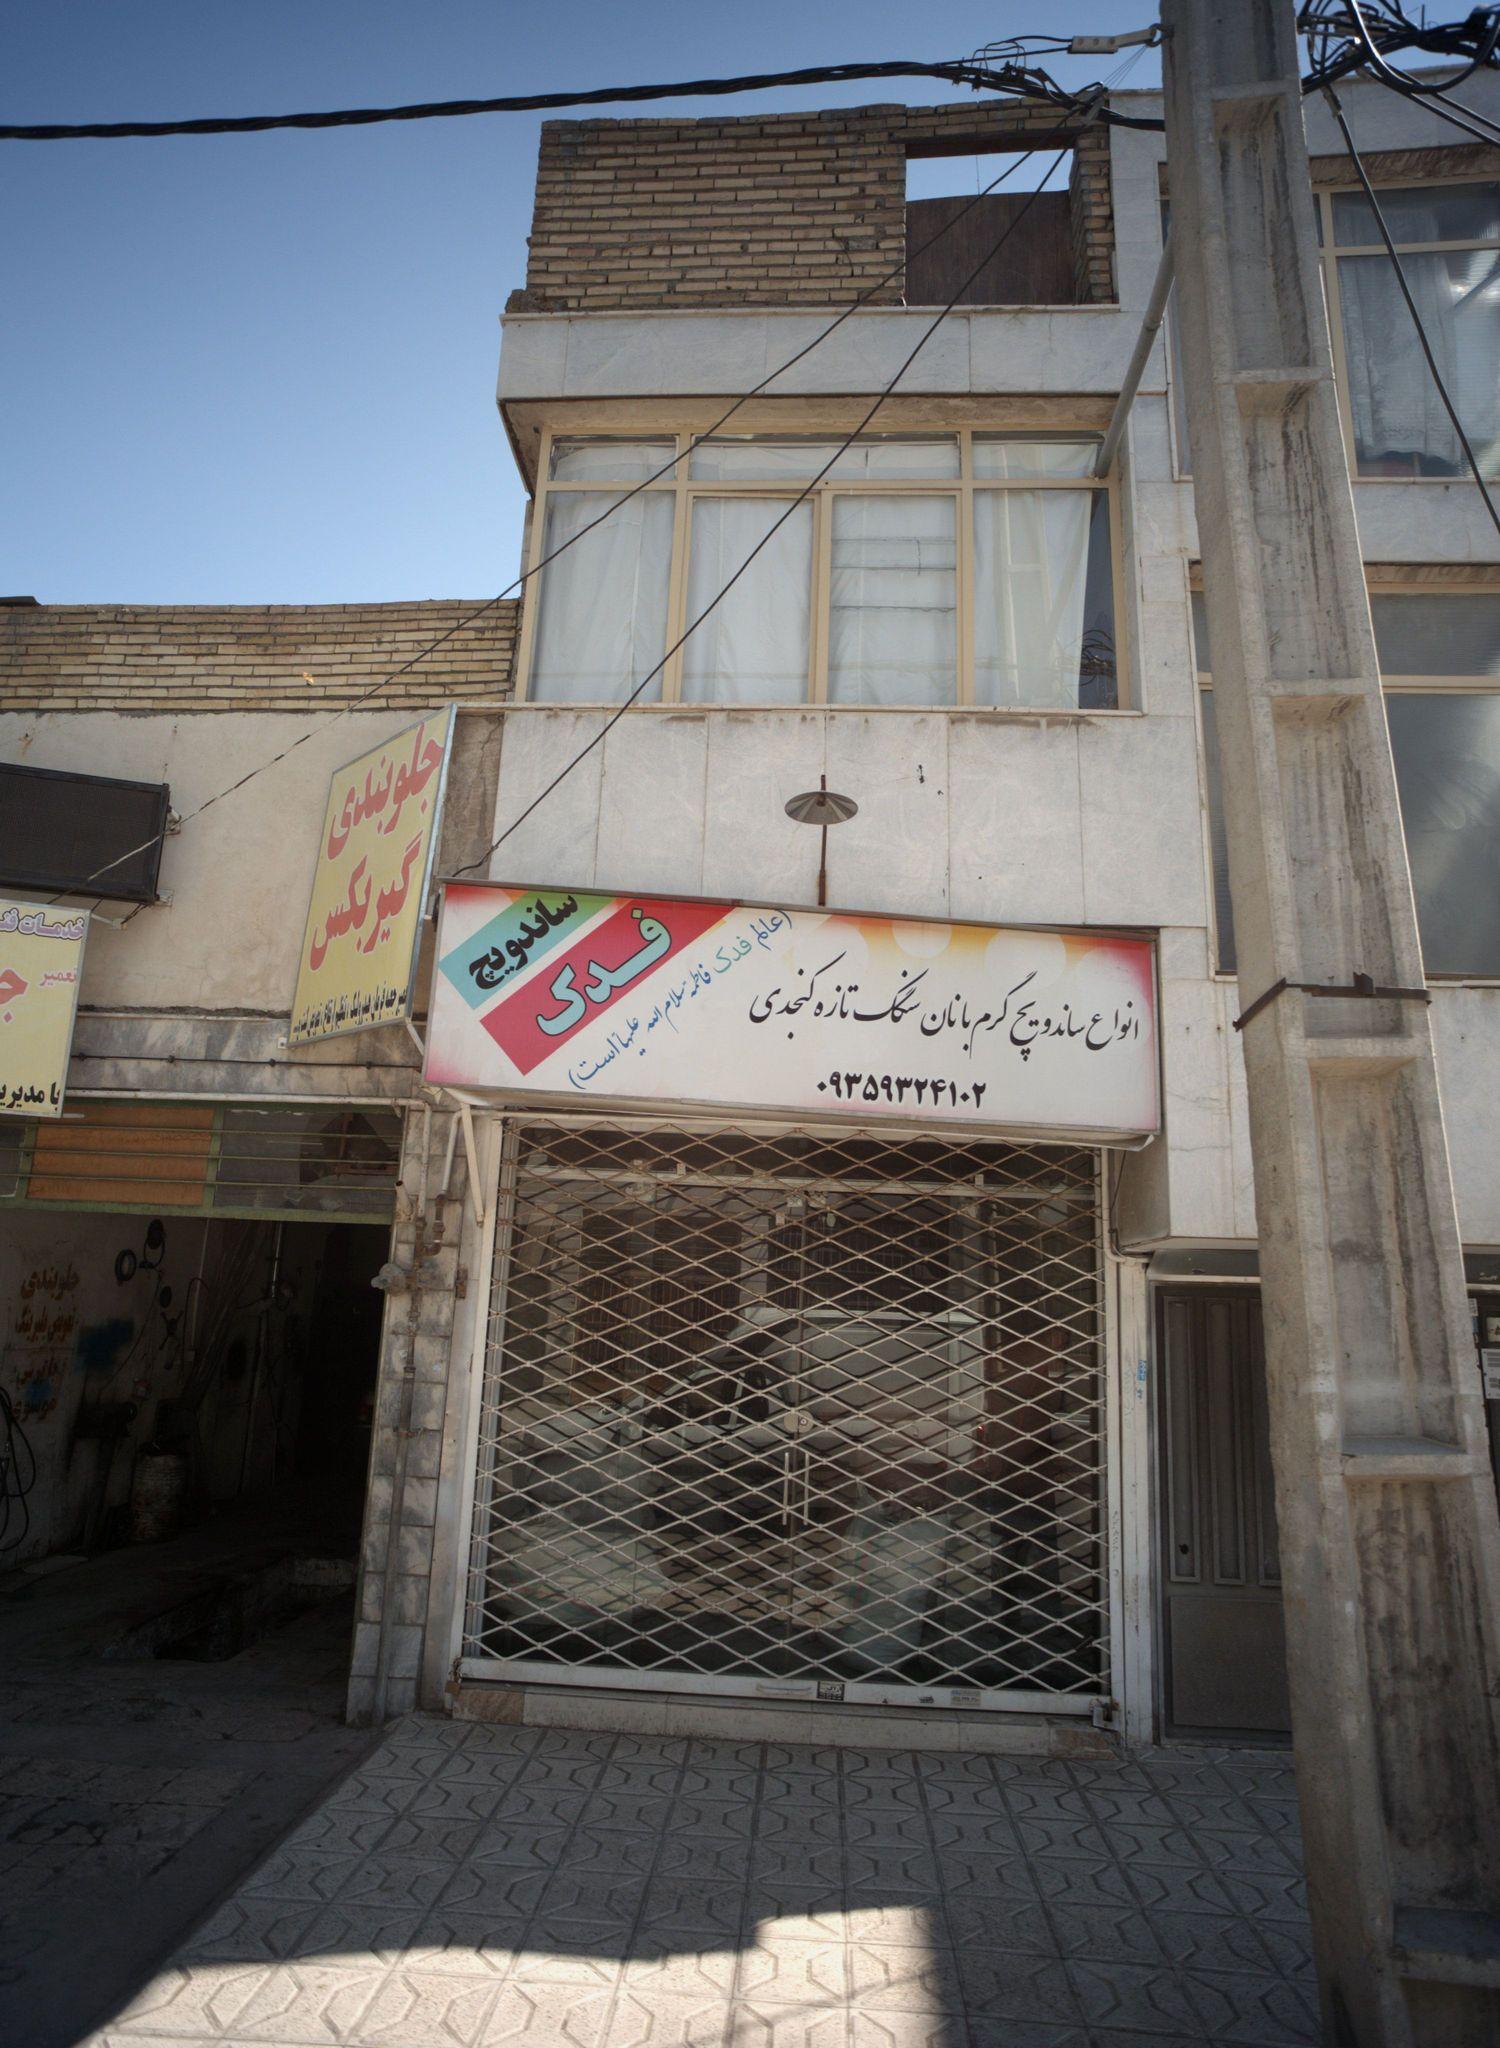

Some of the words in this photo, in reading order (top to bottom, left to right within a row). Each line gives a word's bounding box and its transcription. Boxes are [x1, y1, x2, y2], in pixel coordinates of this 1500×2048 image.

[328, 722, 444, 861] جلوبندی
[18, 911, 85, 941] خدمات
[469, 895, 579, 990] ساندویچ
[536, 908, 672, 1036] فدک
[713, 936, 752, 974] فدک
[749, 951, 847, 1040] کنجدی
[814, 984, 859, 1018] تازه
[920, 993, 961, 1037] نان
[969, 970, 1038, 1060] گرم
[1009, 1001, 1086, 1062] ساندویچ
[1086, 1000, 1139, 1051] انواع
[0, 1084, 45, 1109] مدیری
[817, 1071, 986, 1109] ۰۹۳۵۹۳۲۴۱۰۲
